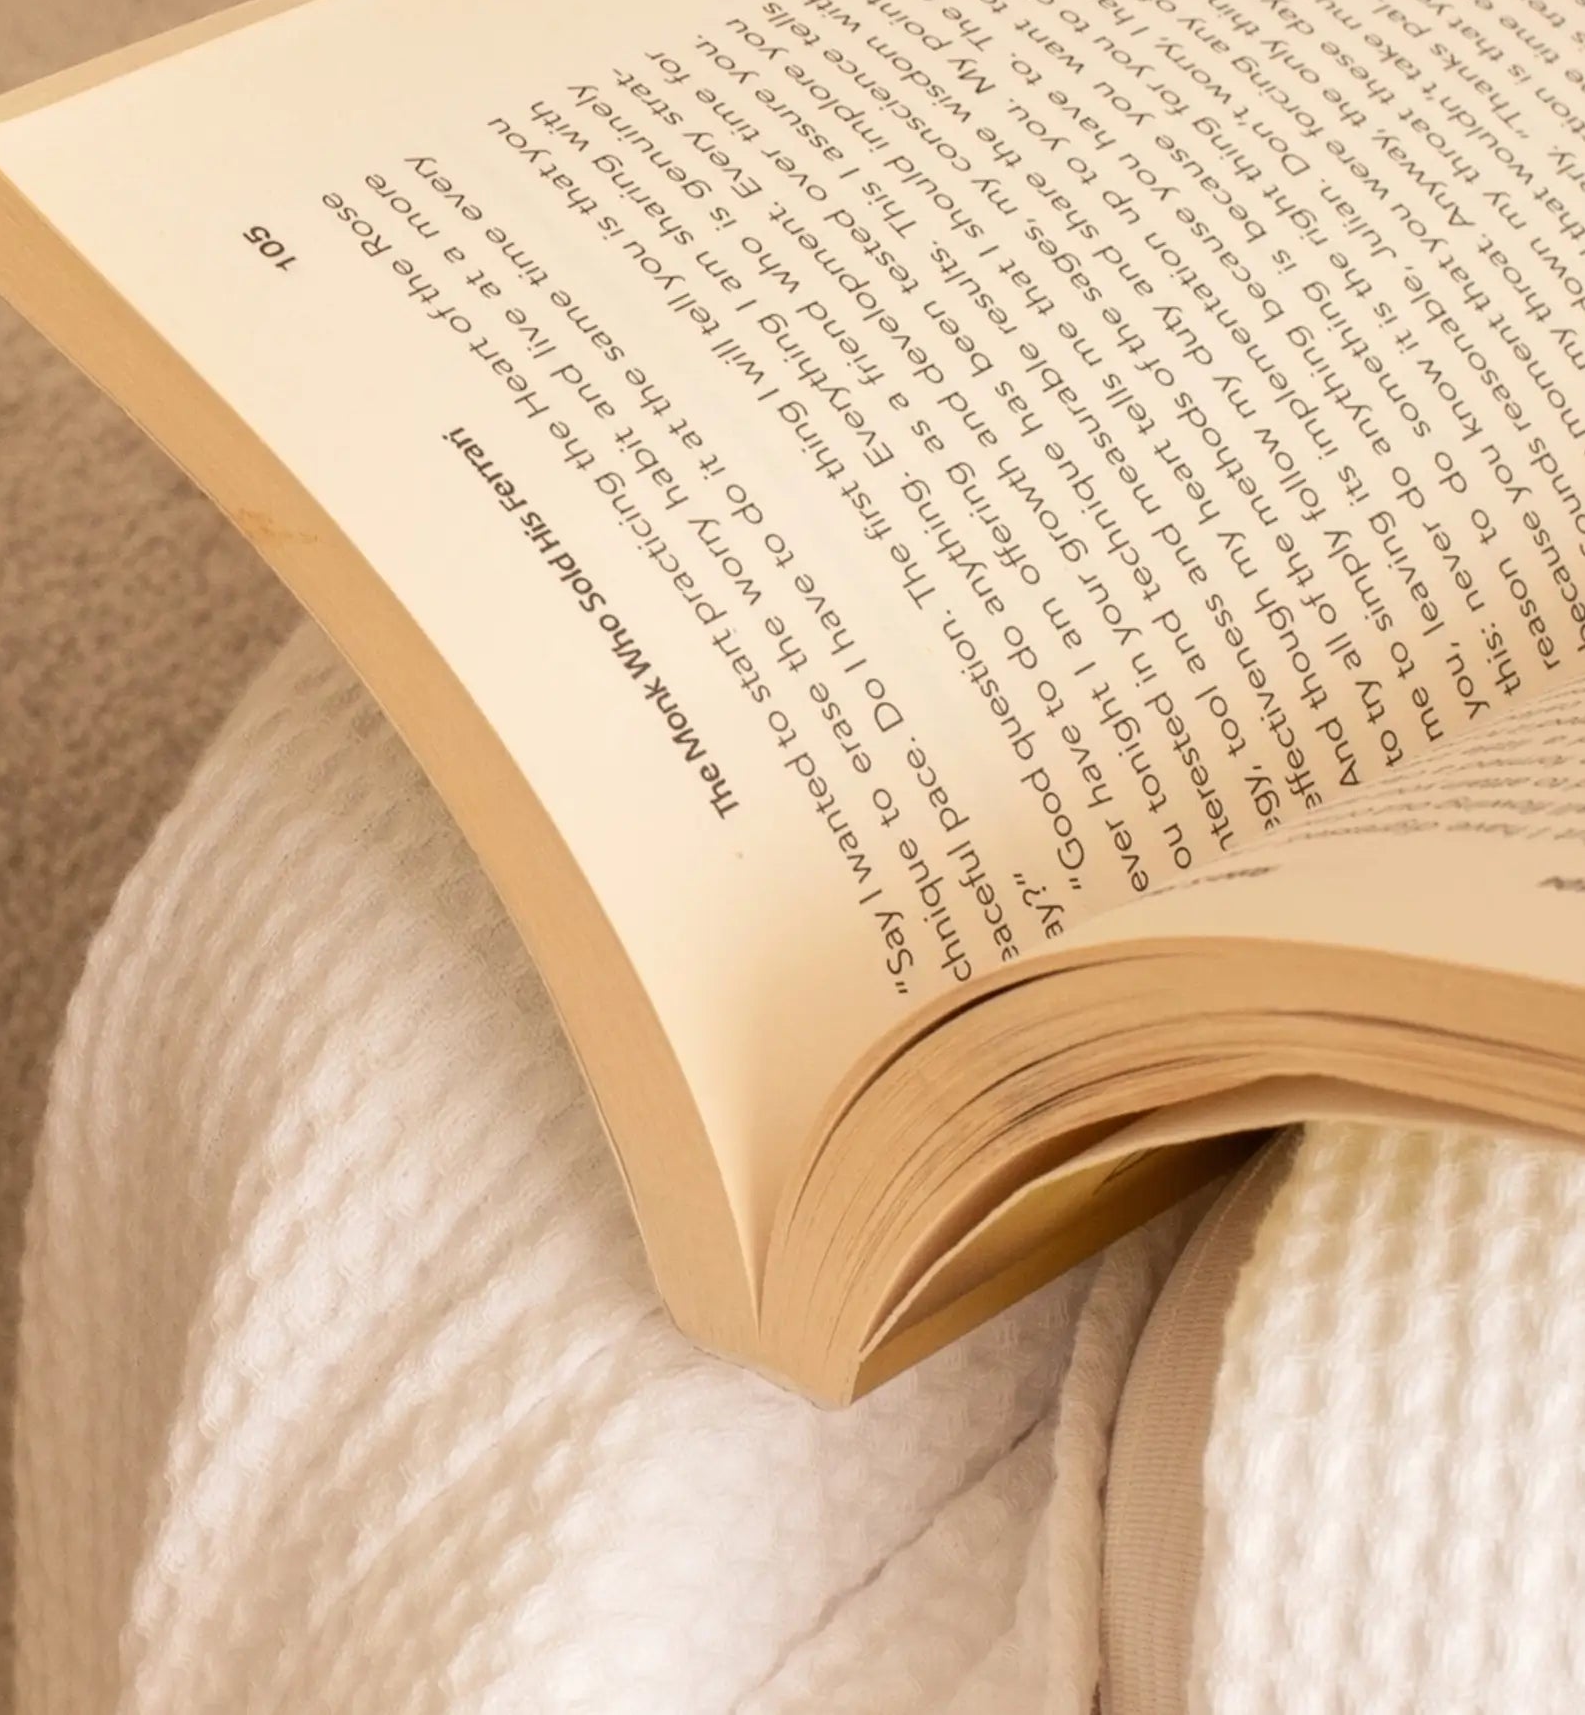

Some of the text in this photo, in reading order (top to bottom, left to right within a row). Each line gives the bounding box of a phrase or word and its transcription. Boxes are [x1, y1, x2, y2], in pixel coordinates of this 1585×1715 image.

[693, 32, 761, 86] you.
[939, 5, 994, 53] The
[1128, 24, 1151, 38] I
[611, 66, 685, 127] strat-
[643, 50, 692, 85] for
[1009, 51, 1044, 87] to.
[1152, 35, 1233, 106] worry,
[485, 115, 553, 165] you
[528, 99, 590, 153] with
[565, 83, 714, 201] genuinely
[693, 86, 761, 144] time
[752, 86, 845, 163] assure
[1045, 88, 1118, 152] have
[401, 155, 484, 222] every
[537, 161, 599, 217] that
[680, 130, 764, 200] Every
[758, 147, 829, 203] over
[836, 165, 861, 181] I
[1116, 151, 1181, 203] you
[319, 190, 394, 259] Rose
[362, 172, 442, 240] more
[589, 152, 695, 247] sharing
[595, 214, 626, 242] is
[707, 204, 738, 233] is
[859, 179, 918, 241] This
[1318, 176, 1398, 260] Julian.
[240, 223, 298, 273] 105
[441, 244, 467, 265] a
[483, 224, 549, 288] time
[620, 238, 687, 292] you
[693, 248, 744, 293] am
[738, 234, 801, 295] who
[821, 206, 920, 295] tested
[1173, 205, 1286, 325] because
[390, 257, 441, 305] the
[463, 267, 503, 300] at
[733, 297, 758, 313] I
[767, 199, 946, 385] development.
[928, 238, 1019, 336] results.
[424, 304, 473, 335] of
[502, 306, 558, 360] live
[548, 288, 626, 363] same
[664, 290, 721, 337] tell
[793, 298, 886, 387] friend
[921, 298, 996, 379] been
[467, 334, 551, 420] Heart
[708, 335, 766, 387] will
[1401, 263, 1533, 433] reasonable,
[547, 361, 617, 420] and
[622, 365, 672, 418] the
[755, 311, 896, 469] Everything
[755, 385, 781, 403] I
[886, 390, 911, 412] a
[934, 389, 1000, 449] and
[992, 378, 1045, 439] has
[1283, 323, 1393, 457] anything
[546, 419, 597, 472] the
[666, 416, 705, 451] at
[775, 398, 847, 482] thing
[908, 417, 946, 454] as
[1016, 340, 1163, 516] measurable
[613, 424, 690, 512] habit
[697, 451, 727, 481] it
[1389, 464, 1427, 510] do
[723, 481, 765, 526] do
[839, 478, 893, 542] first
[943, 459, 1042, 587] offering
[995, 452, 1090, 564] growth
[1042, 440, 1162, 603] technique
[591, 469, 729, 627] practicing
[685, 516, 763, 607] worry
[762, 531, 795, 570] to
[898, 469, 1006, 617] anything.
[1148, 520, 1209, 587] and
[1420, 520, 1487, 614] never
[888, 540, 937, 611] The
[439, 424, 741, 822] The Monk Who Sold His Ferrari
[792, 571, 856, 657] have
[1040, 595, 1084, 651] am
[1076, 572, 1144, 647] your
[710, 626, 773, 705] start
[762, 613, 809, 674] the
[842, 656, 868, 675] I
[1001, 623, 1039, 671] do
[1071, 659, 1098, 678] I
[1129, 649, 1159, 689] in
[1149, 606, 1207, 675] and
[1478, 620, 1523, 698] this:
[862, 675, 906, 734] Do
[940, 607, 1037, 762] question.
[1035, 677, 1066, 719] to
[766, 708, 798, 750] to
[807, 680, 873, 775] erase
[1089, 679, 1168, 816] tonight
[1192, 683, 1248, 759] tool
[904, 734, 971, 834] pace.
[1059, 722, 1115, 810] have
[782, 749, 873, 886] wanted
[870, 785, 901, 829] to
[856, 886, 884, 906] I
